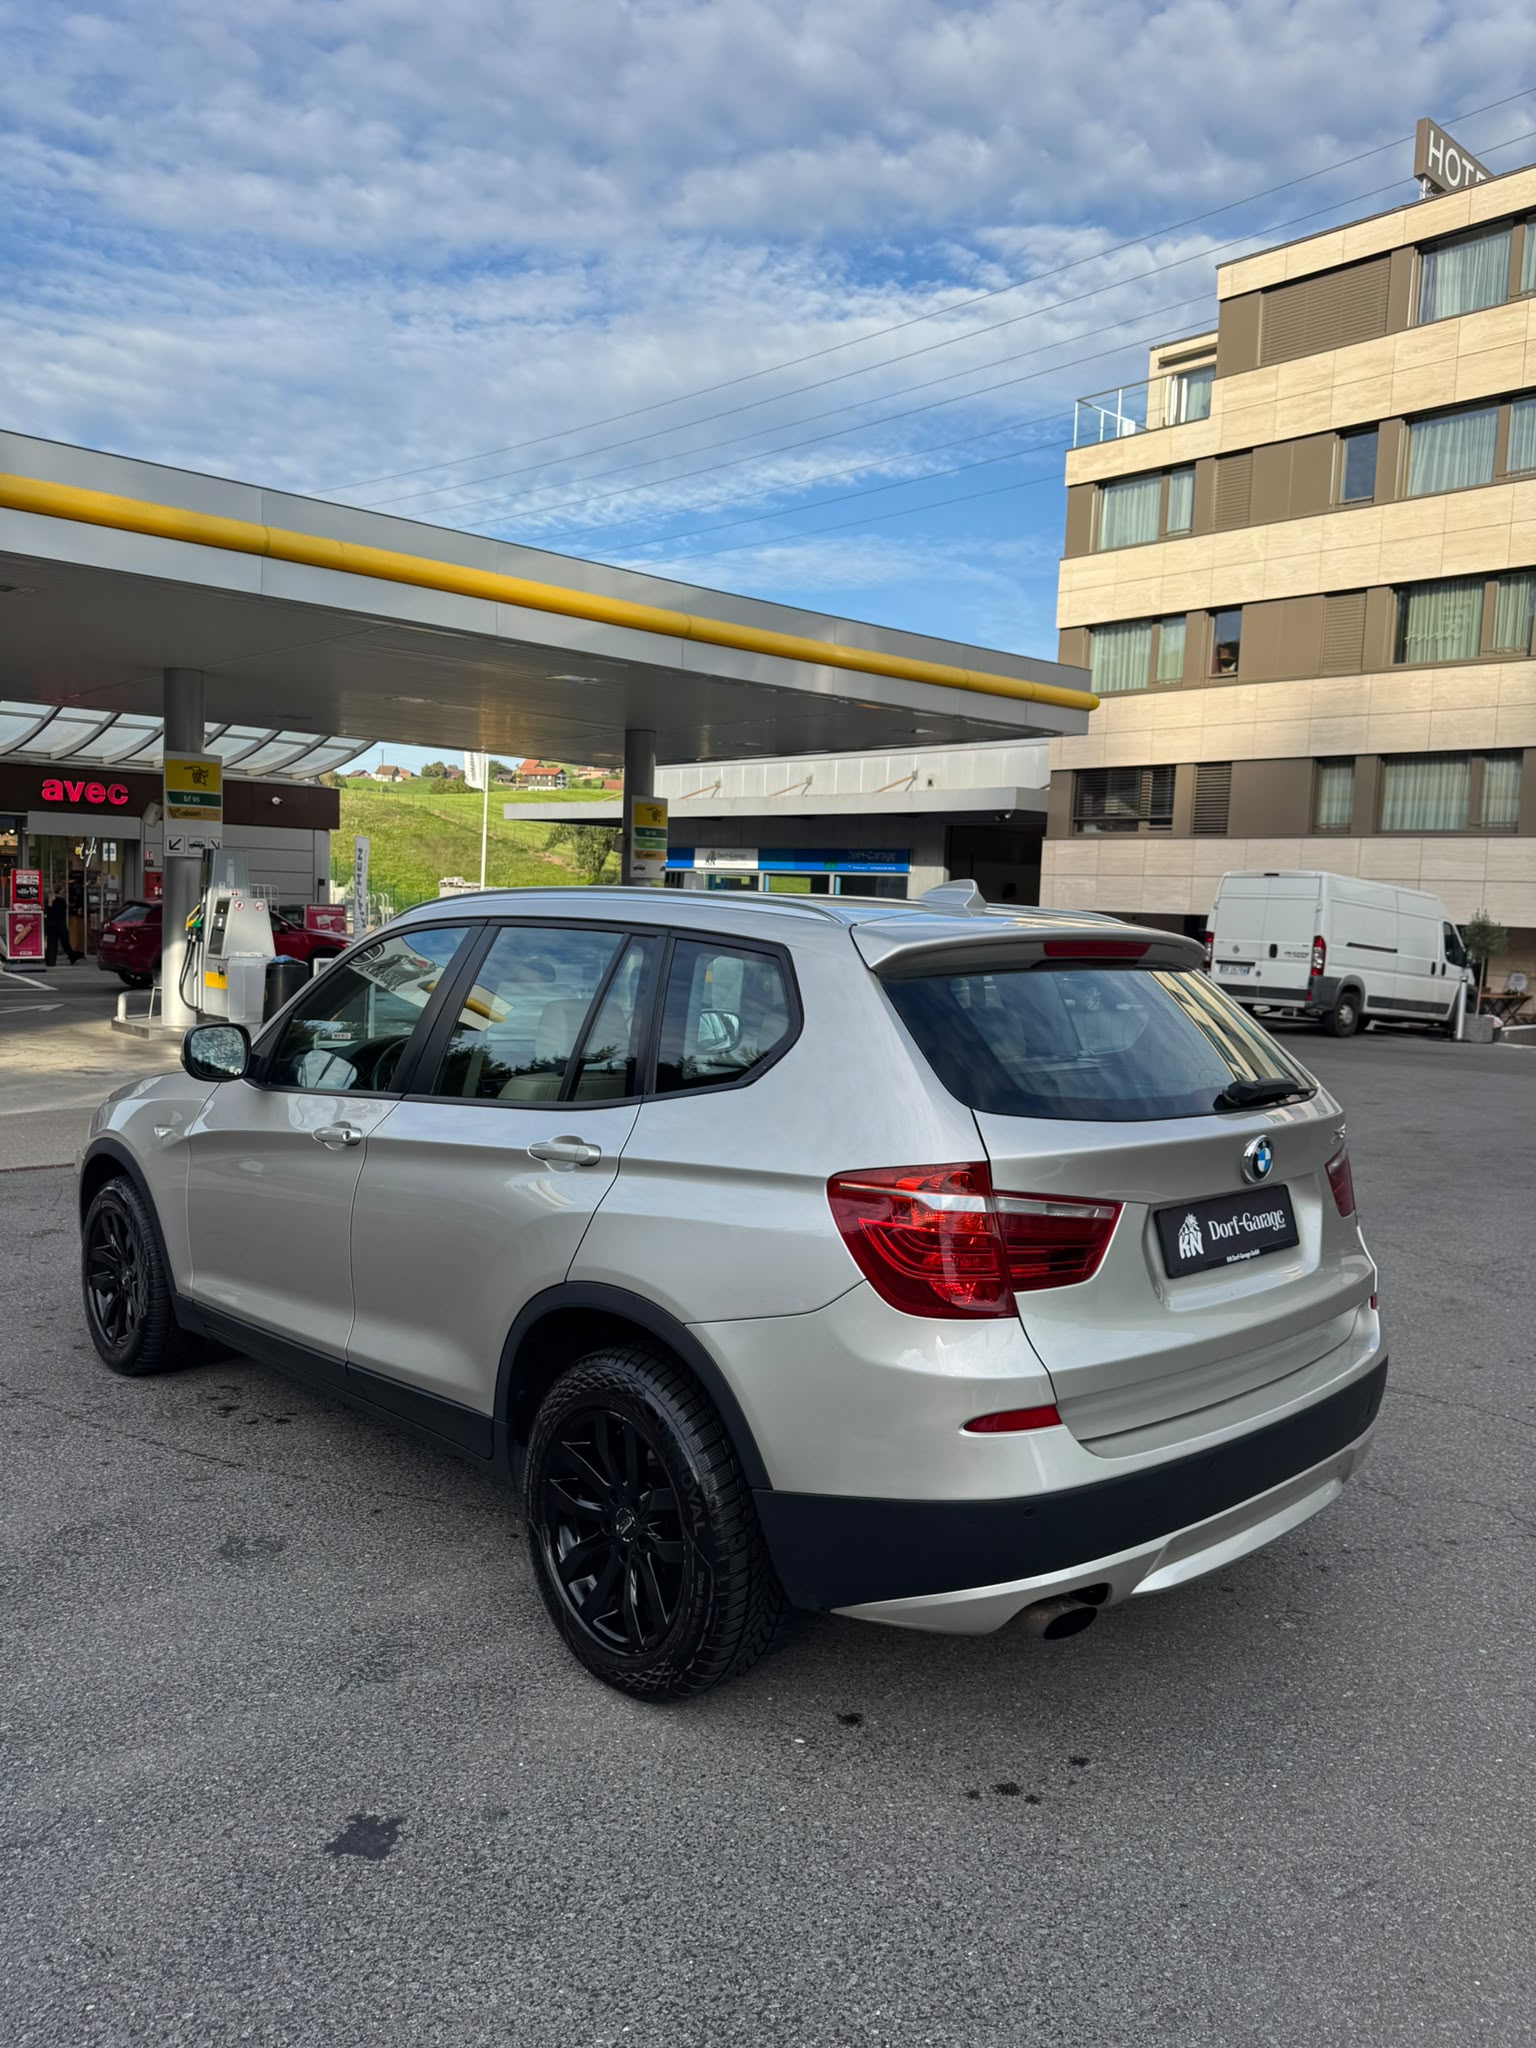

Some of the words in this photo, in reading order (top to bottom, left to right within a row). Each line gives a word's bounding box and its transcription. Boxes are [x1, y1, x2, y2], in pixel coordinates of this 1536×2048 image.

[41, 779, 128, 805] avec
[1208, 1209, 1286, 1241] Dorf-Garage
[1178, 1231, 1205, 1260] KN
